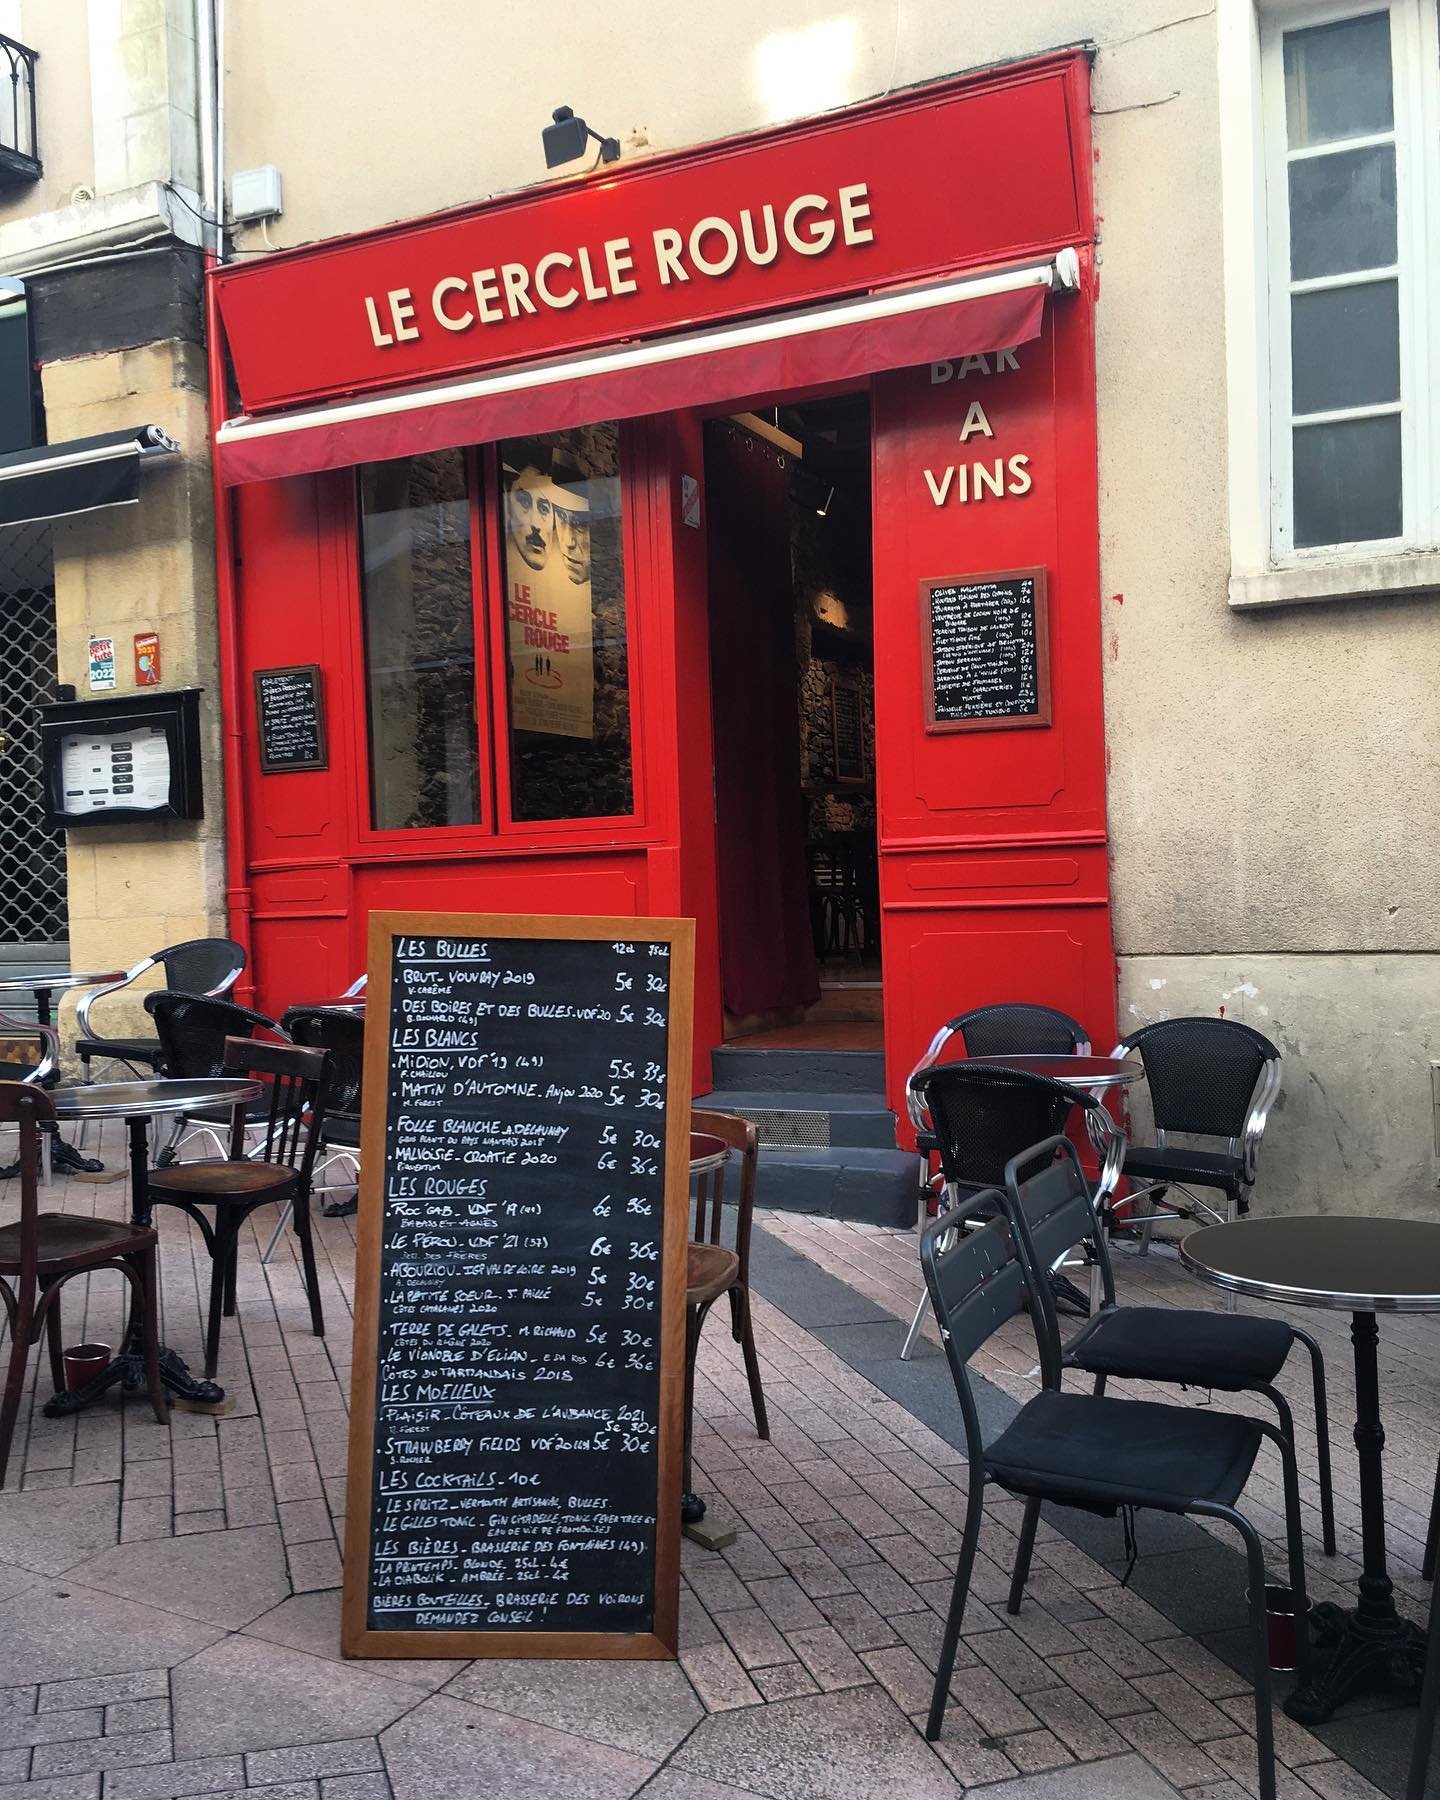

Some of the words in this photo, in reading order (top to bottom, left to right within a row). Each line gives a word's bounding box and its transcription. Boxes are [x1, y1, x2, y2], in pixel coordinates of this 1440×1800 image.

[364, 287, 420, 348] LE
[431, 236, 637, 332] CERCLE
[652, 181, 874, 285] ROUGE
[959, 400, 993, 441] A
[923, 453, 1032, 506] VINS
[514, 582, 531, 605] LE
[524, 626, 570, 655] ROUGE
[91, 668, 115, 680] 2022
[396, 937, 426, 958] LES
[436, 940, 489, 958] BULLES
[449, 970, 500, 988] VOUVRAY
[503, 971, 535, 984] 2019
[615, 972, 633, 991] 5€
[646, 974, 667, 992] 30€
[402, 1000, 426, 1013] DES
[476, 1003, 496, 1016] ET
[499, 1005, 521, 1016] DES
[616, 1004, 634, 1023] 5€
[643, 1007, 666, 1027] 30€
[393, 1028, 419, 1048] LES
[425, 1029, 479, 1047] BLANCS
[458, 1054, 489, 1068] VDF
[643, 1062, 666, 1084] 33€
[453, 1079, 538, 1097] D'AUTOMNE
[577, 1085, 603, 1098] 2020
[604, 1085, 626, 1106] 5€
[634, 1088, 665, 1110] 30€
[397, 1116, 436, 1133] FOLLE
[442, 1119, 500, 1133] BLANCHE
[598, 1125, 617, 1145] 5€
[633, 1129, 660, 1149] 30€
[521, 1152, 557, 1165] 2020
[597, 1151, 618, 1169] 6€
[630, 1156, 658, 1175] 36€
[388, 1176, 418, 1197] LES
[424, 1178, 488, 1196] ROUGES
[593, 1194, 612, 1217] 6€
[626, 1197, 652, 1216] 36€
[390, 1232, 408, 1249] LE
[413, 1231, 457, 1248] PÉROU
[590, 1236, 612, 1257] 6€
[628, 1241, 659, 1260] 36€
[551, 1265, 576, 1276] 2019
[588, 1267, 608, 1285] 5€
[626, 1272, 655, 1291] 30€
[390, 1290, 404, 1303] LA
[581, 1292, 603, 1307] 5€
[621, 1295, 655, 1310] 30€
[390, 1323, 431, 1337] TERRE
[438, 1324, 455, 1337] DE
[458, 1323, 509, 1337] GALETS
[585, 1325, 608, 1344] 5€
[621, 1329, 653, 1347] 30€
[387, 1347, 402, 1361] LE
[595, 1352, 616, 1368] 6€
[625, 1352, 653, 1371] 36€
[533, 1367, 574, 1381] 2018
[382, 1383, 411, 1401] LES
[416, 1383, 497, 1401] MOELLEUX
[513, 1408, 536, 1420] DE
[617, 1404, 645, 1422] 2021
[604, 1420, 621, 1433] 5€
[630, 1421, 657, 1436] 30€
[384, 1437, 474, 1456] STRAWBERRY
[592, 1431, 611, 1451] 5€
[620, 1433, 650, 1453] 30€
[379, 1470, 409, 1491] LES
[508, 1471, 542, 1486] 10€
[386, 1499, 401, 1514] LE
[383, 1516, 397, 1532] LE
[508, 1526, 520, 1536] DE
[375, 1540, 399, 1556] LES
[533, 1541, 553, 1552] DES
[379, 1562, 392, 1574] LA
[549, 1556, 568, 1569] 4€
[379, 1575, 391, 1587] LA
[566, 1593, 591, 1605] DES
[415, 1612, 480, 1624] DEMANDEZ
